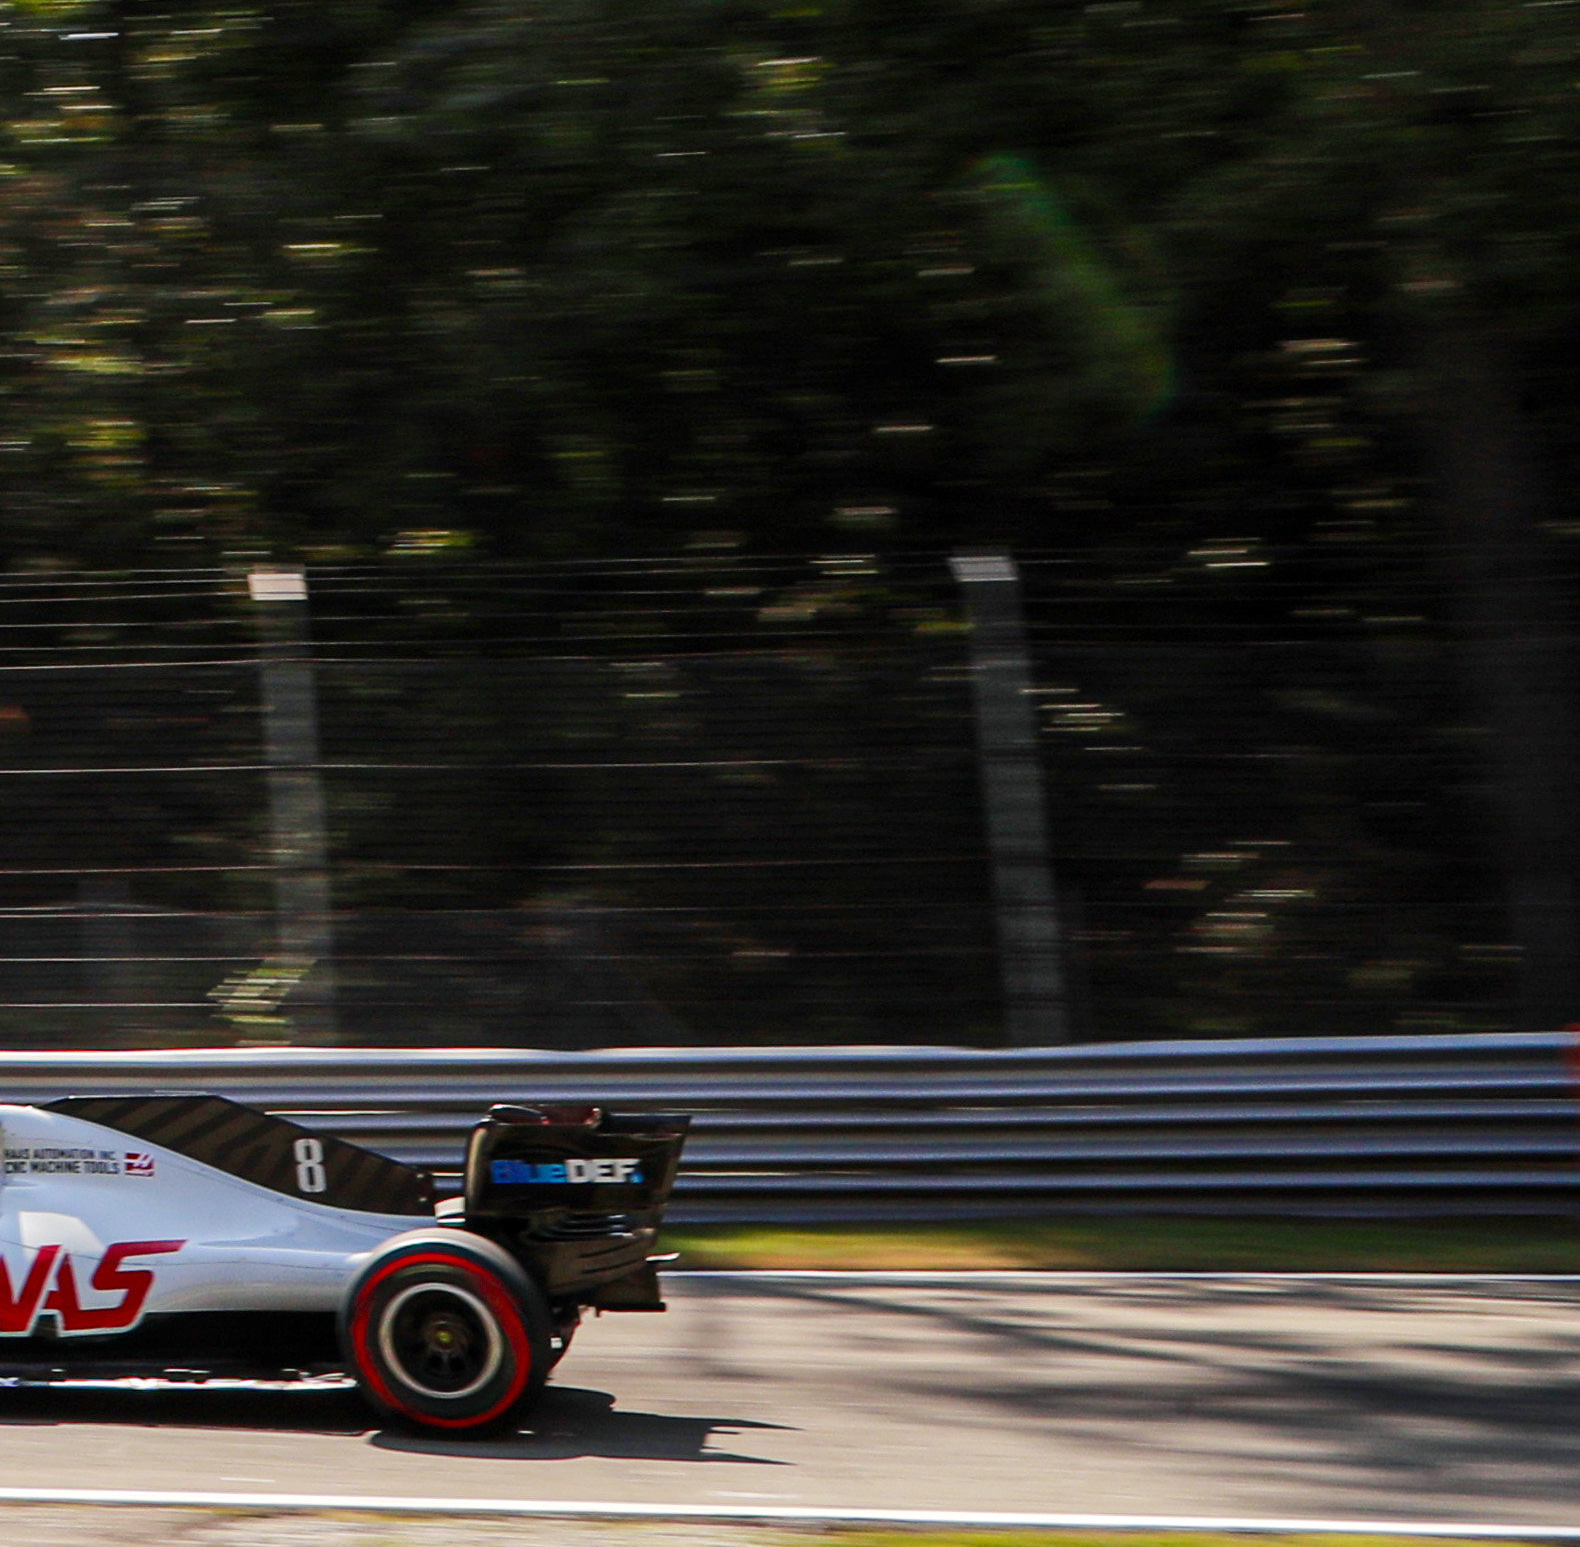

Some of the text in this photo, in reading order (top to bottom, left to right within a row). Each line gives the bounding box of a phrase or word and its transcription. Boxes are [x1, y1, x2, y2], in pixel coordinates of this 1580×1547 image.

[4, 1161, 121, 1175] CNC MACHINE TOOLS
[293, 1138, 327, 1193] 8
